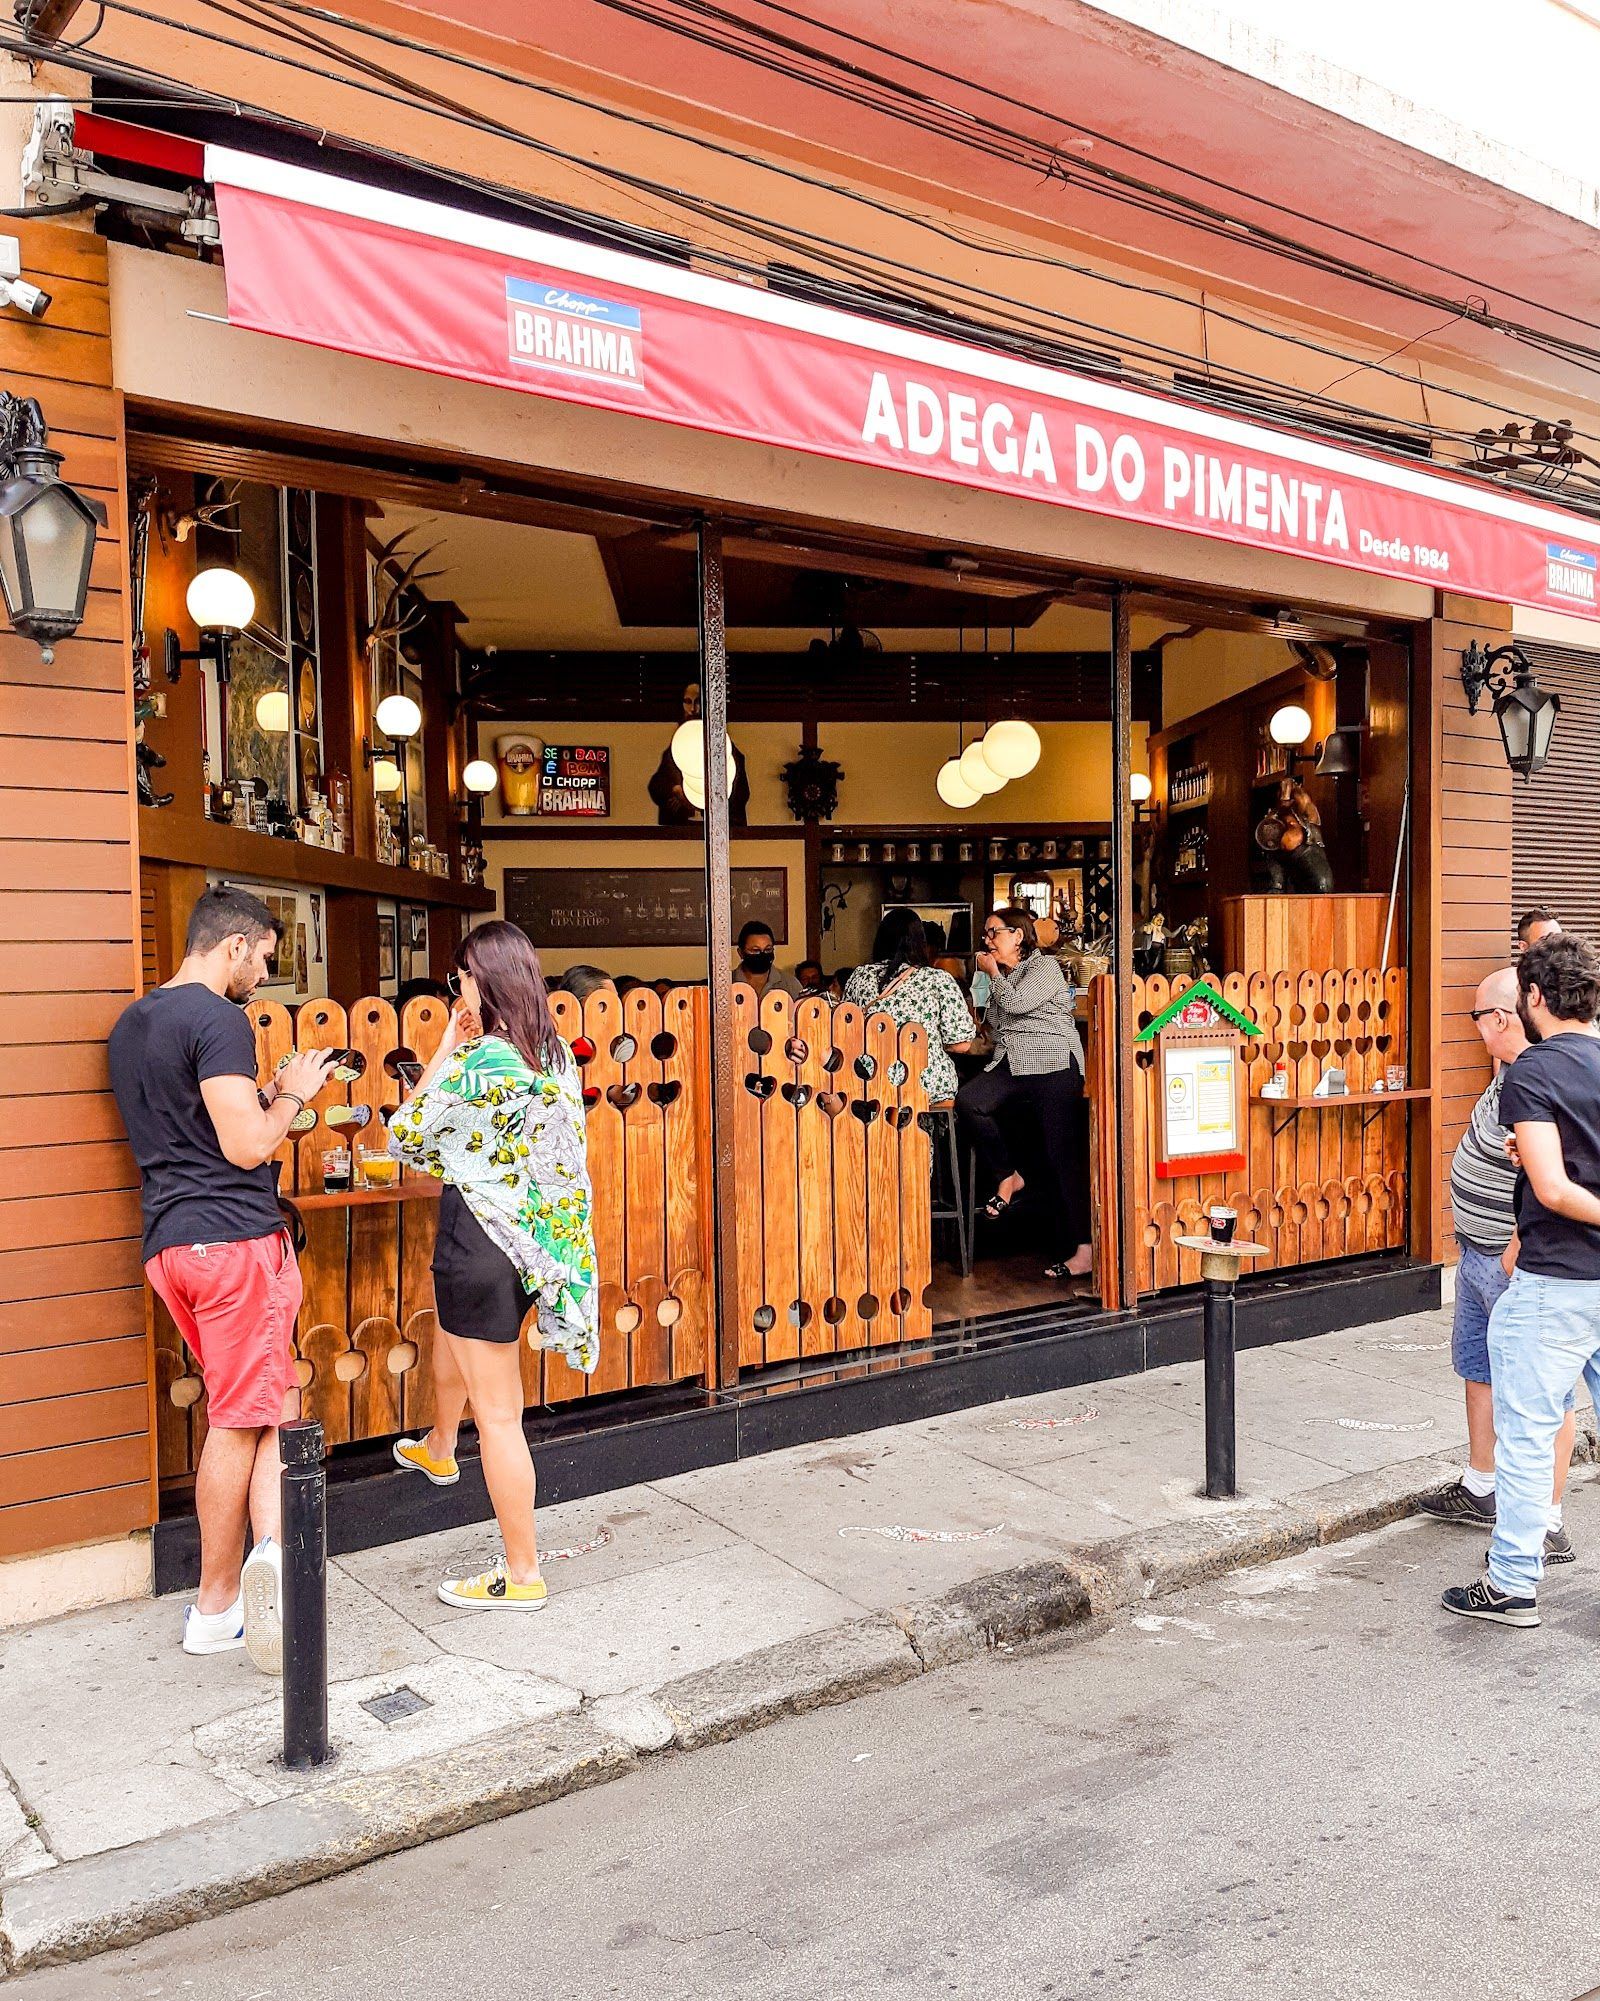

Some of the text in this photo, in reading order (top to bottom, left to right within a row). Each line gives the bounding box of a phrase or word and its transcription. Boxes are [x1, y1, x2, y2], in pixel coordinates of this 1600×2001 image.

[544, 290, 609, 315] Chopp
[514, 309, 636, 377] BRAHMA
[861, 371, 1450, 572] ADEGA DO PIMENTA Desde 1984
[1548, 562, 1594, 599] BRAHMA
[507, 753, 533, 763] BRAHMA
[544, 747, 558, 760] SE
[575, 748, 607, 763] BAR
[546, 760, 600, 775] É BOM
[542, 776, 552, 786] O
[556, 776, 597, 788] CHOPP
[543, 789, 607, 812] BRAHMA
